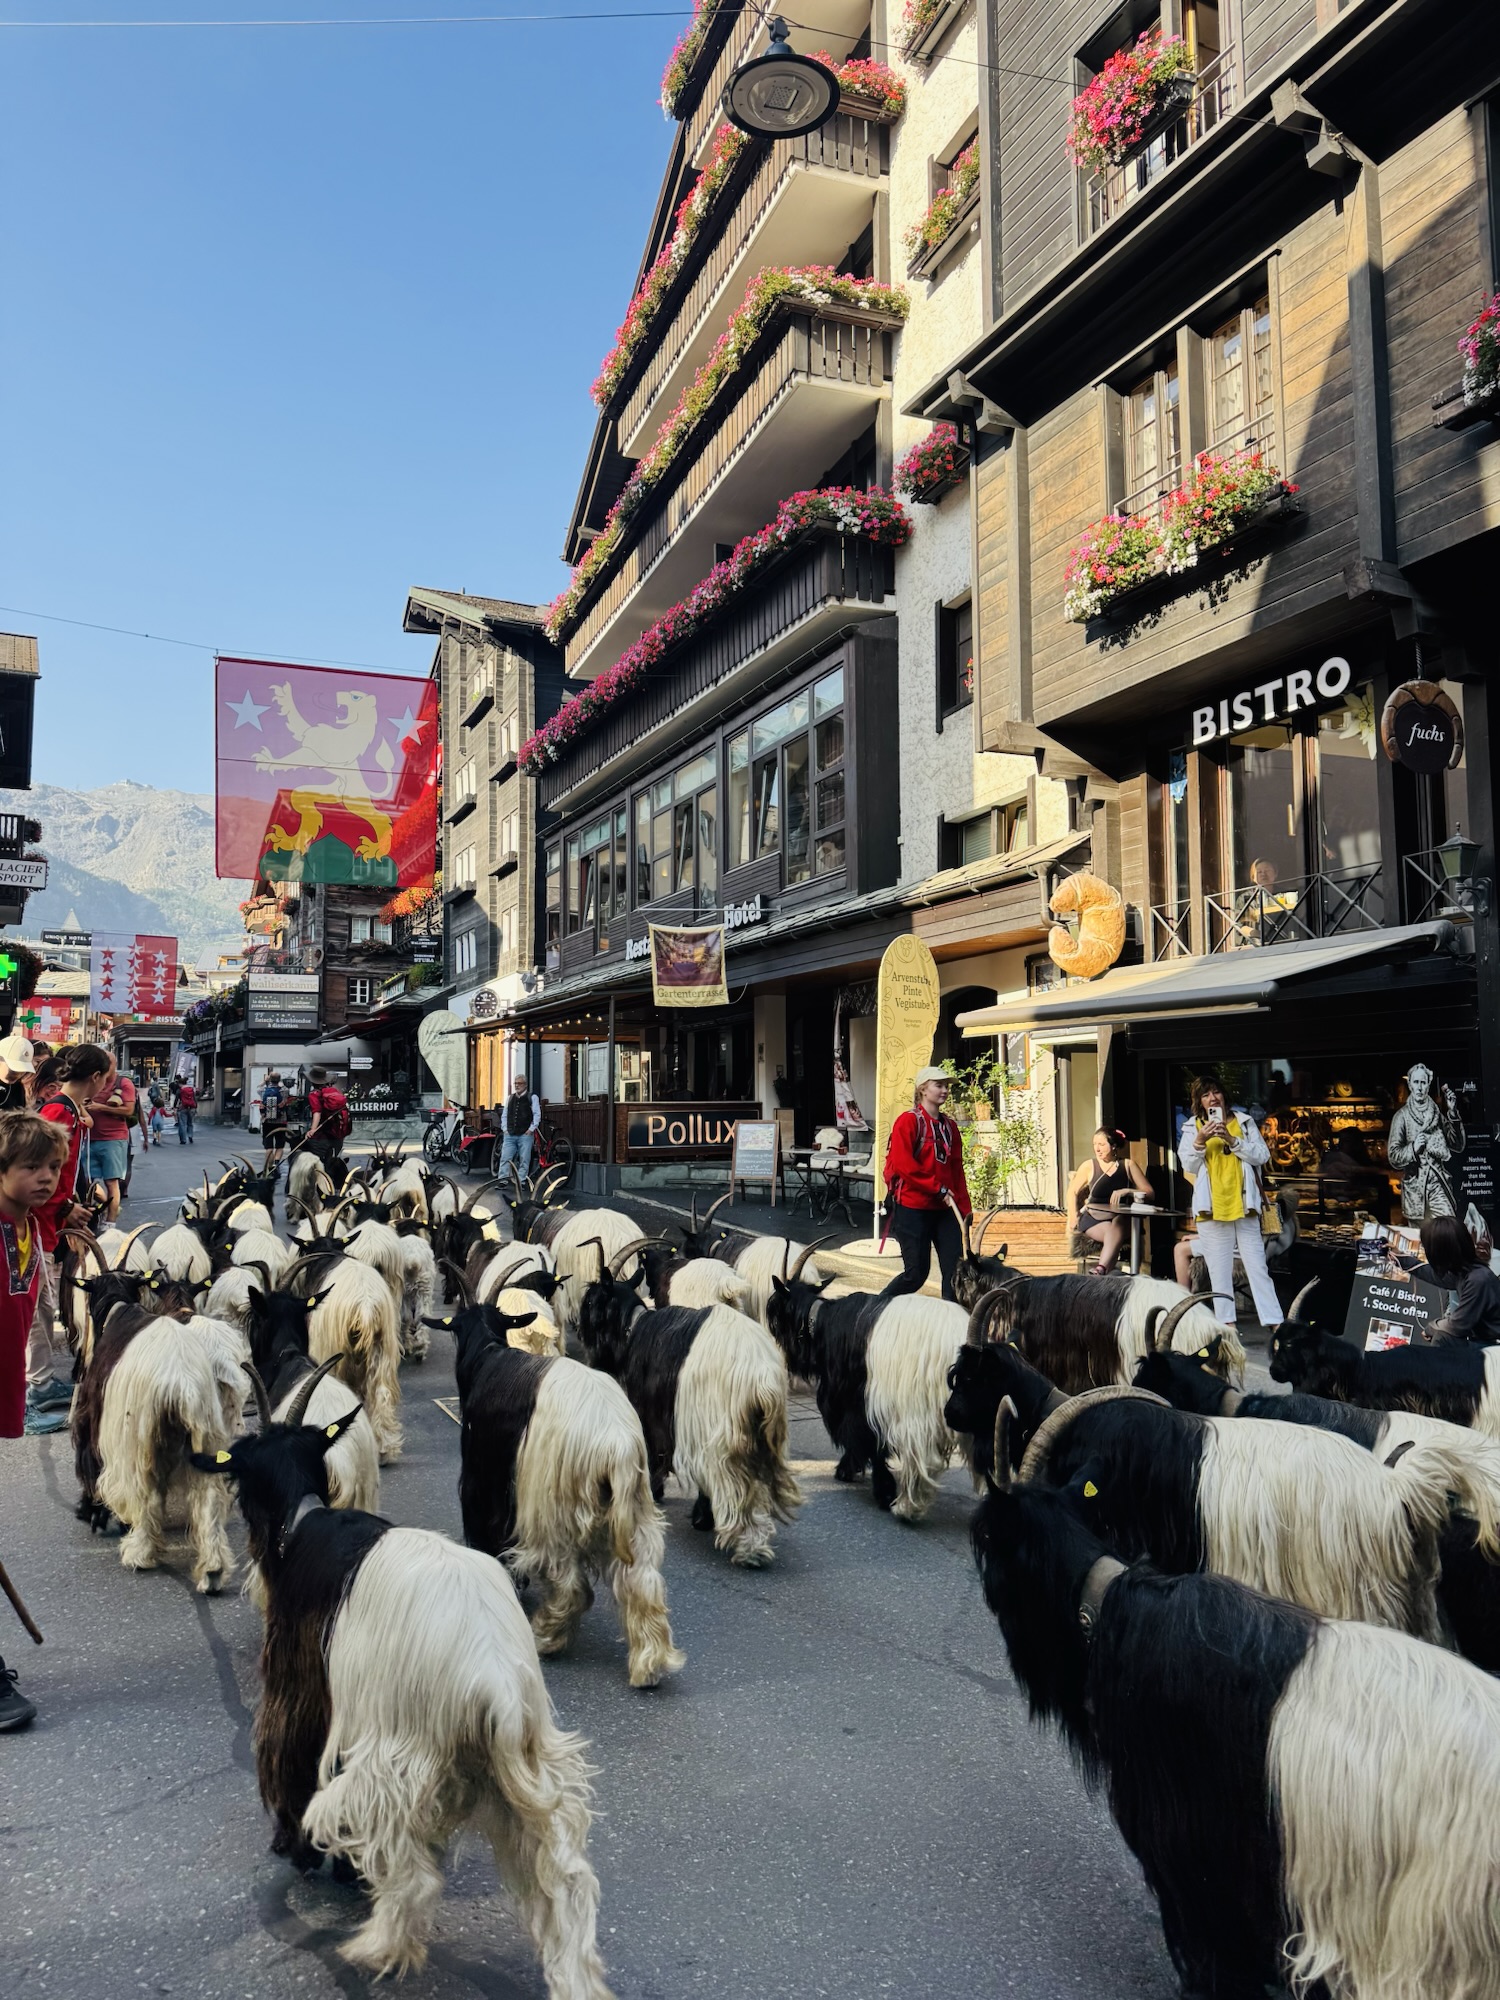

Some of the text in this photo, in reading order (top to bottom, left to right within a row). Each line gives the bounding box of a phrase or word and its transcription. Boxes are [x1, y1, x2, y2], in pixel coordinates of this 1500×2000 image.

[1193, 656, 1350, 746] BISTRO
[1405, 721, 1446, 747] fuchs
[0, 862, 43, 874] LACIER
[723, 893, 762, 930] Hotel
[656, 987, 725, 998] Gartenterrasse
[903, 984, 922, 996] Pinte
[895, 997, 930, 1011] Vegistube
[347, 1102, 399, 1112] LLISERHOF
[648, 1113, 736, 1145] Pollux
[1368, 1284, 1427, 1304] Café / Bistro
[1362, 1296, 1371, 1308] 1.
[1372, 1298, 1400, 1314] Stock
